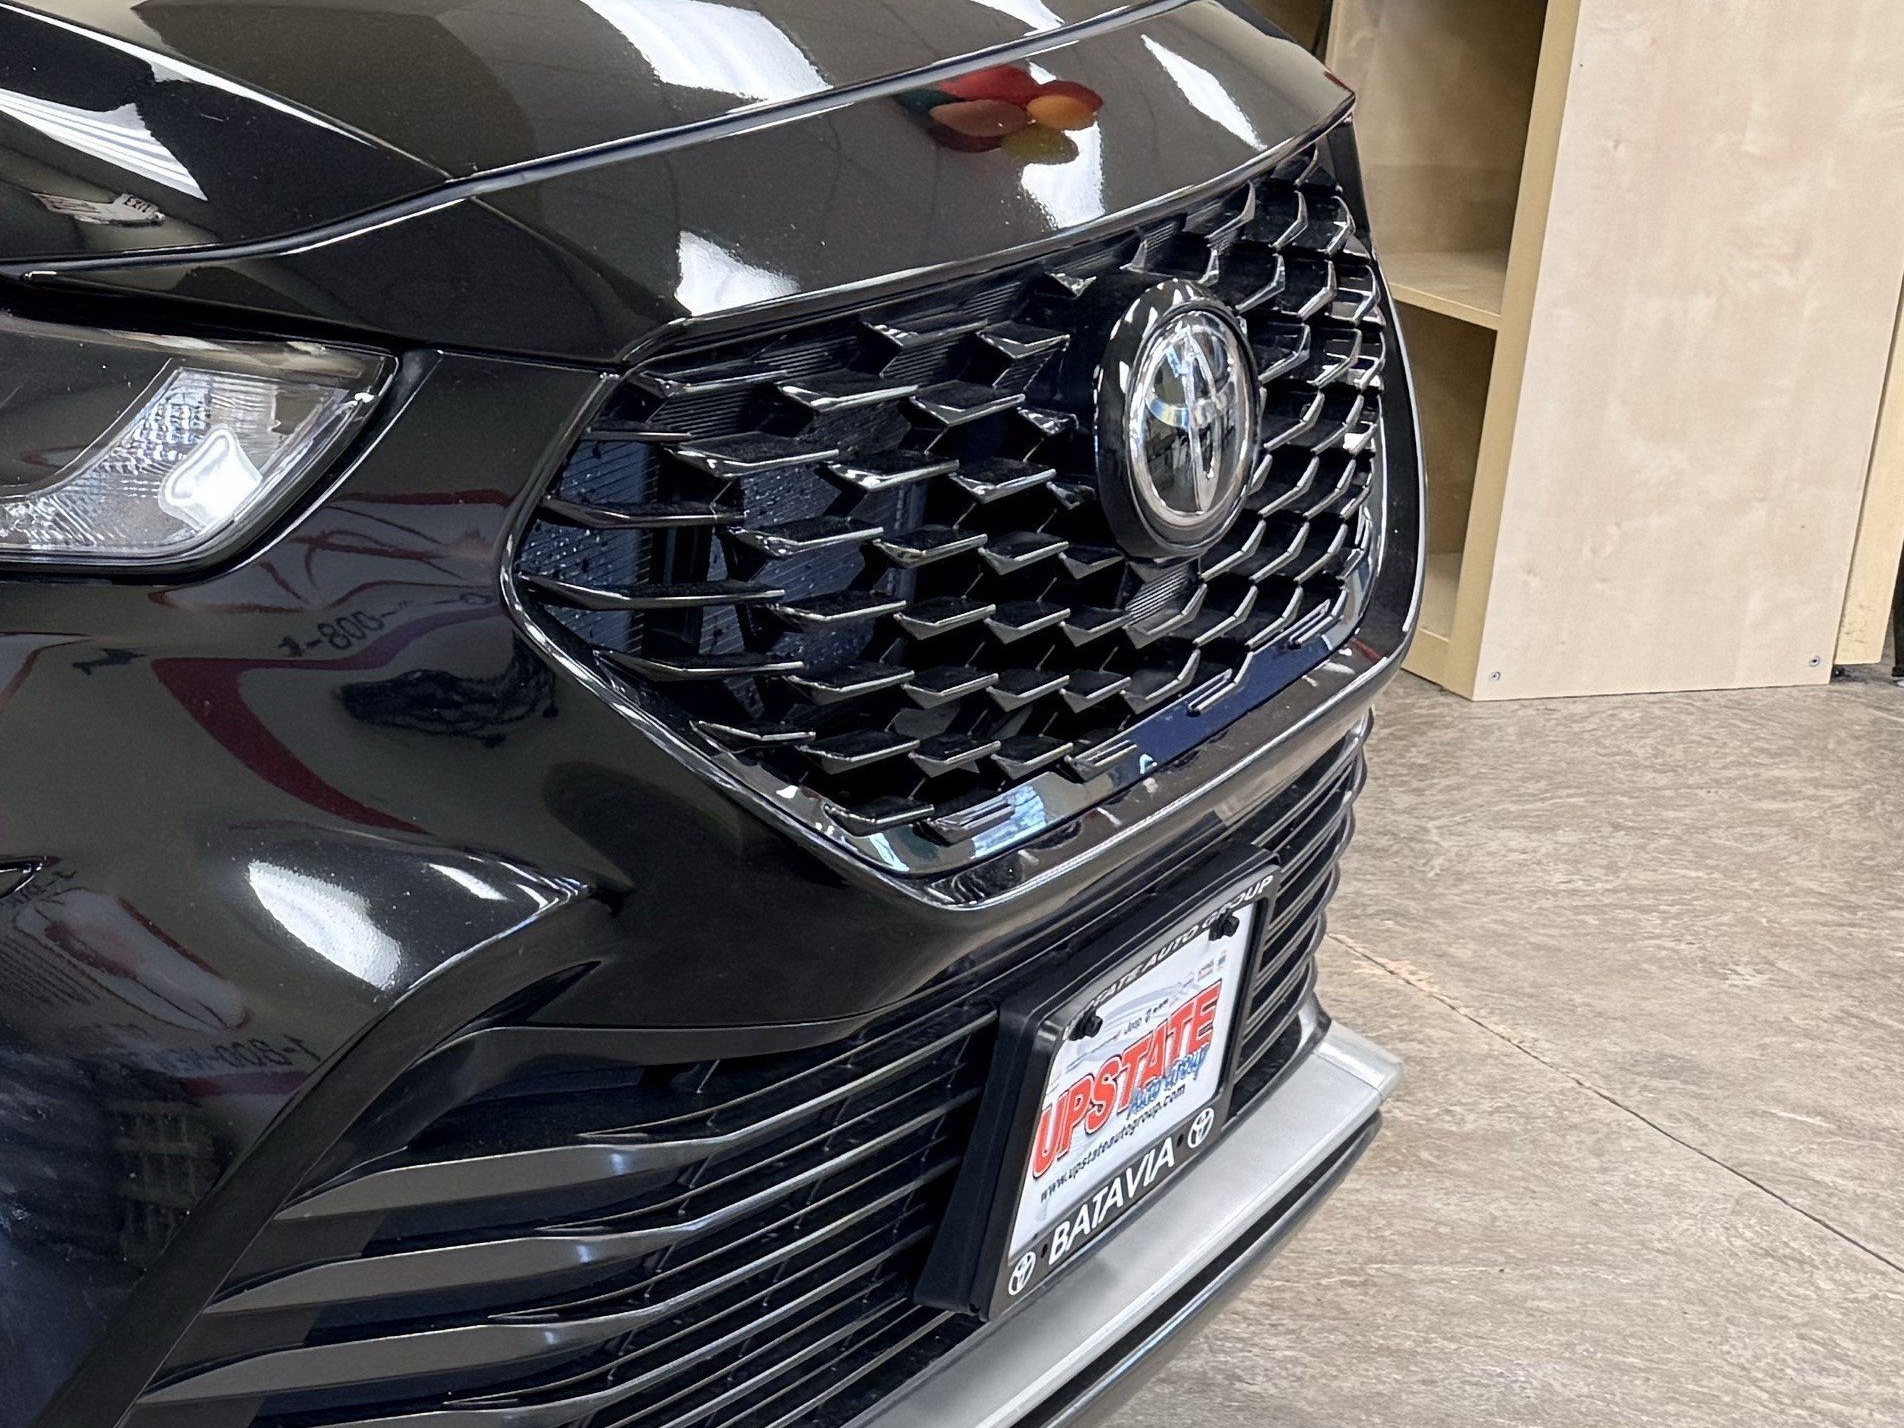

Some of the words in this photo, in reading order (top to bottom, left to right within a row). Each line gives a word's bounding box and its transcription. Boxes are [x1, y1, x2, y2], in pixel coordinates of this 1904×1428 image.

[1141, 924, 1200, 972] AUTO
[1031, 980, 1222, 1181] UPSTATE
[1040, 1083, 1186, 1203] www.upstateautogroup.com
[1048, 1137, 1175, 1265] BATAVIA
